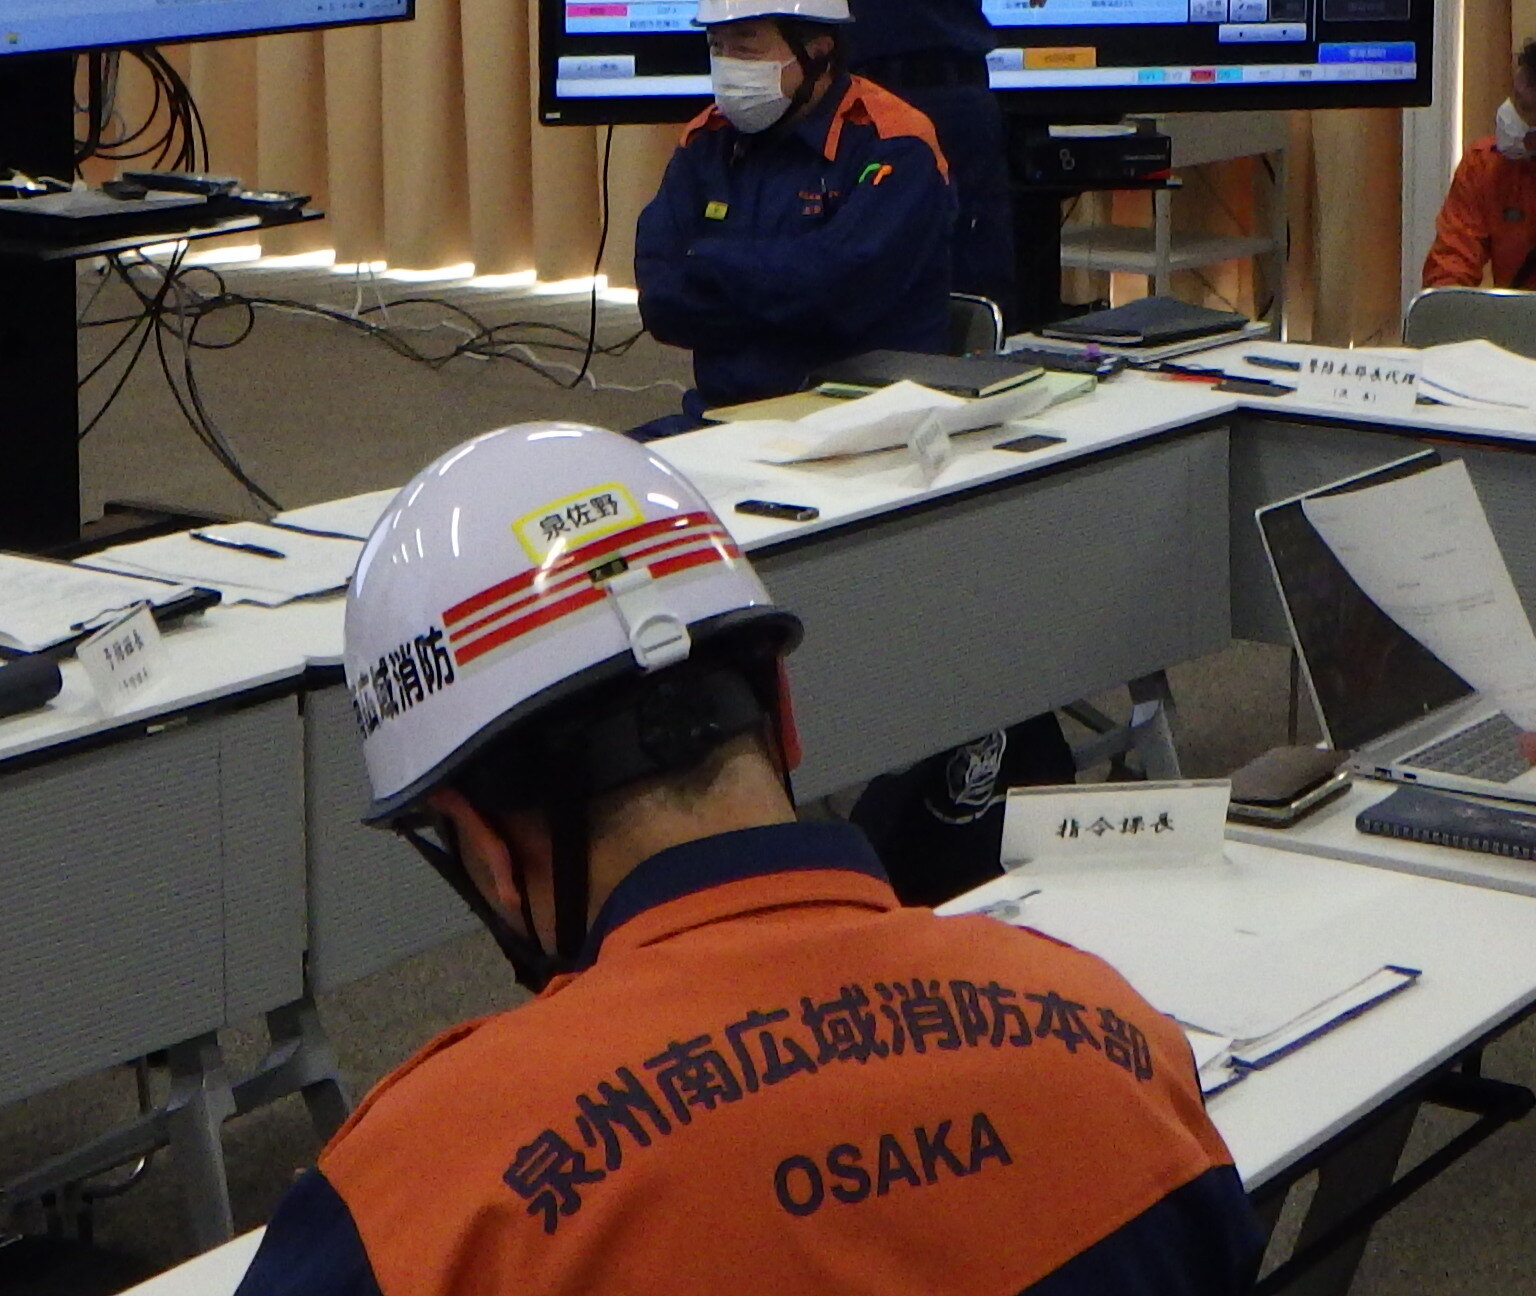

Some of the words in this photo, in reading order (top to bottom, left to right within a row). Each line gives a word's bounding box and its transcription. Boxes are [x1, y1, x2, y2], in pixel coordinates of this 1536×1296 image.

[539, 493, 619, 542] 泉佐野
[501, 977, 1154, 1235] 泉州南広域消防本部
[773, 1111, 1013, 1218] OSAKA
